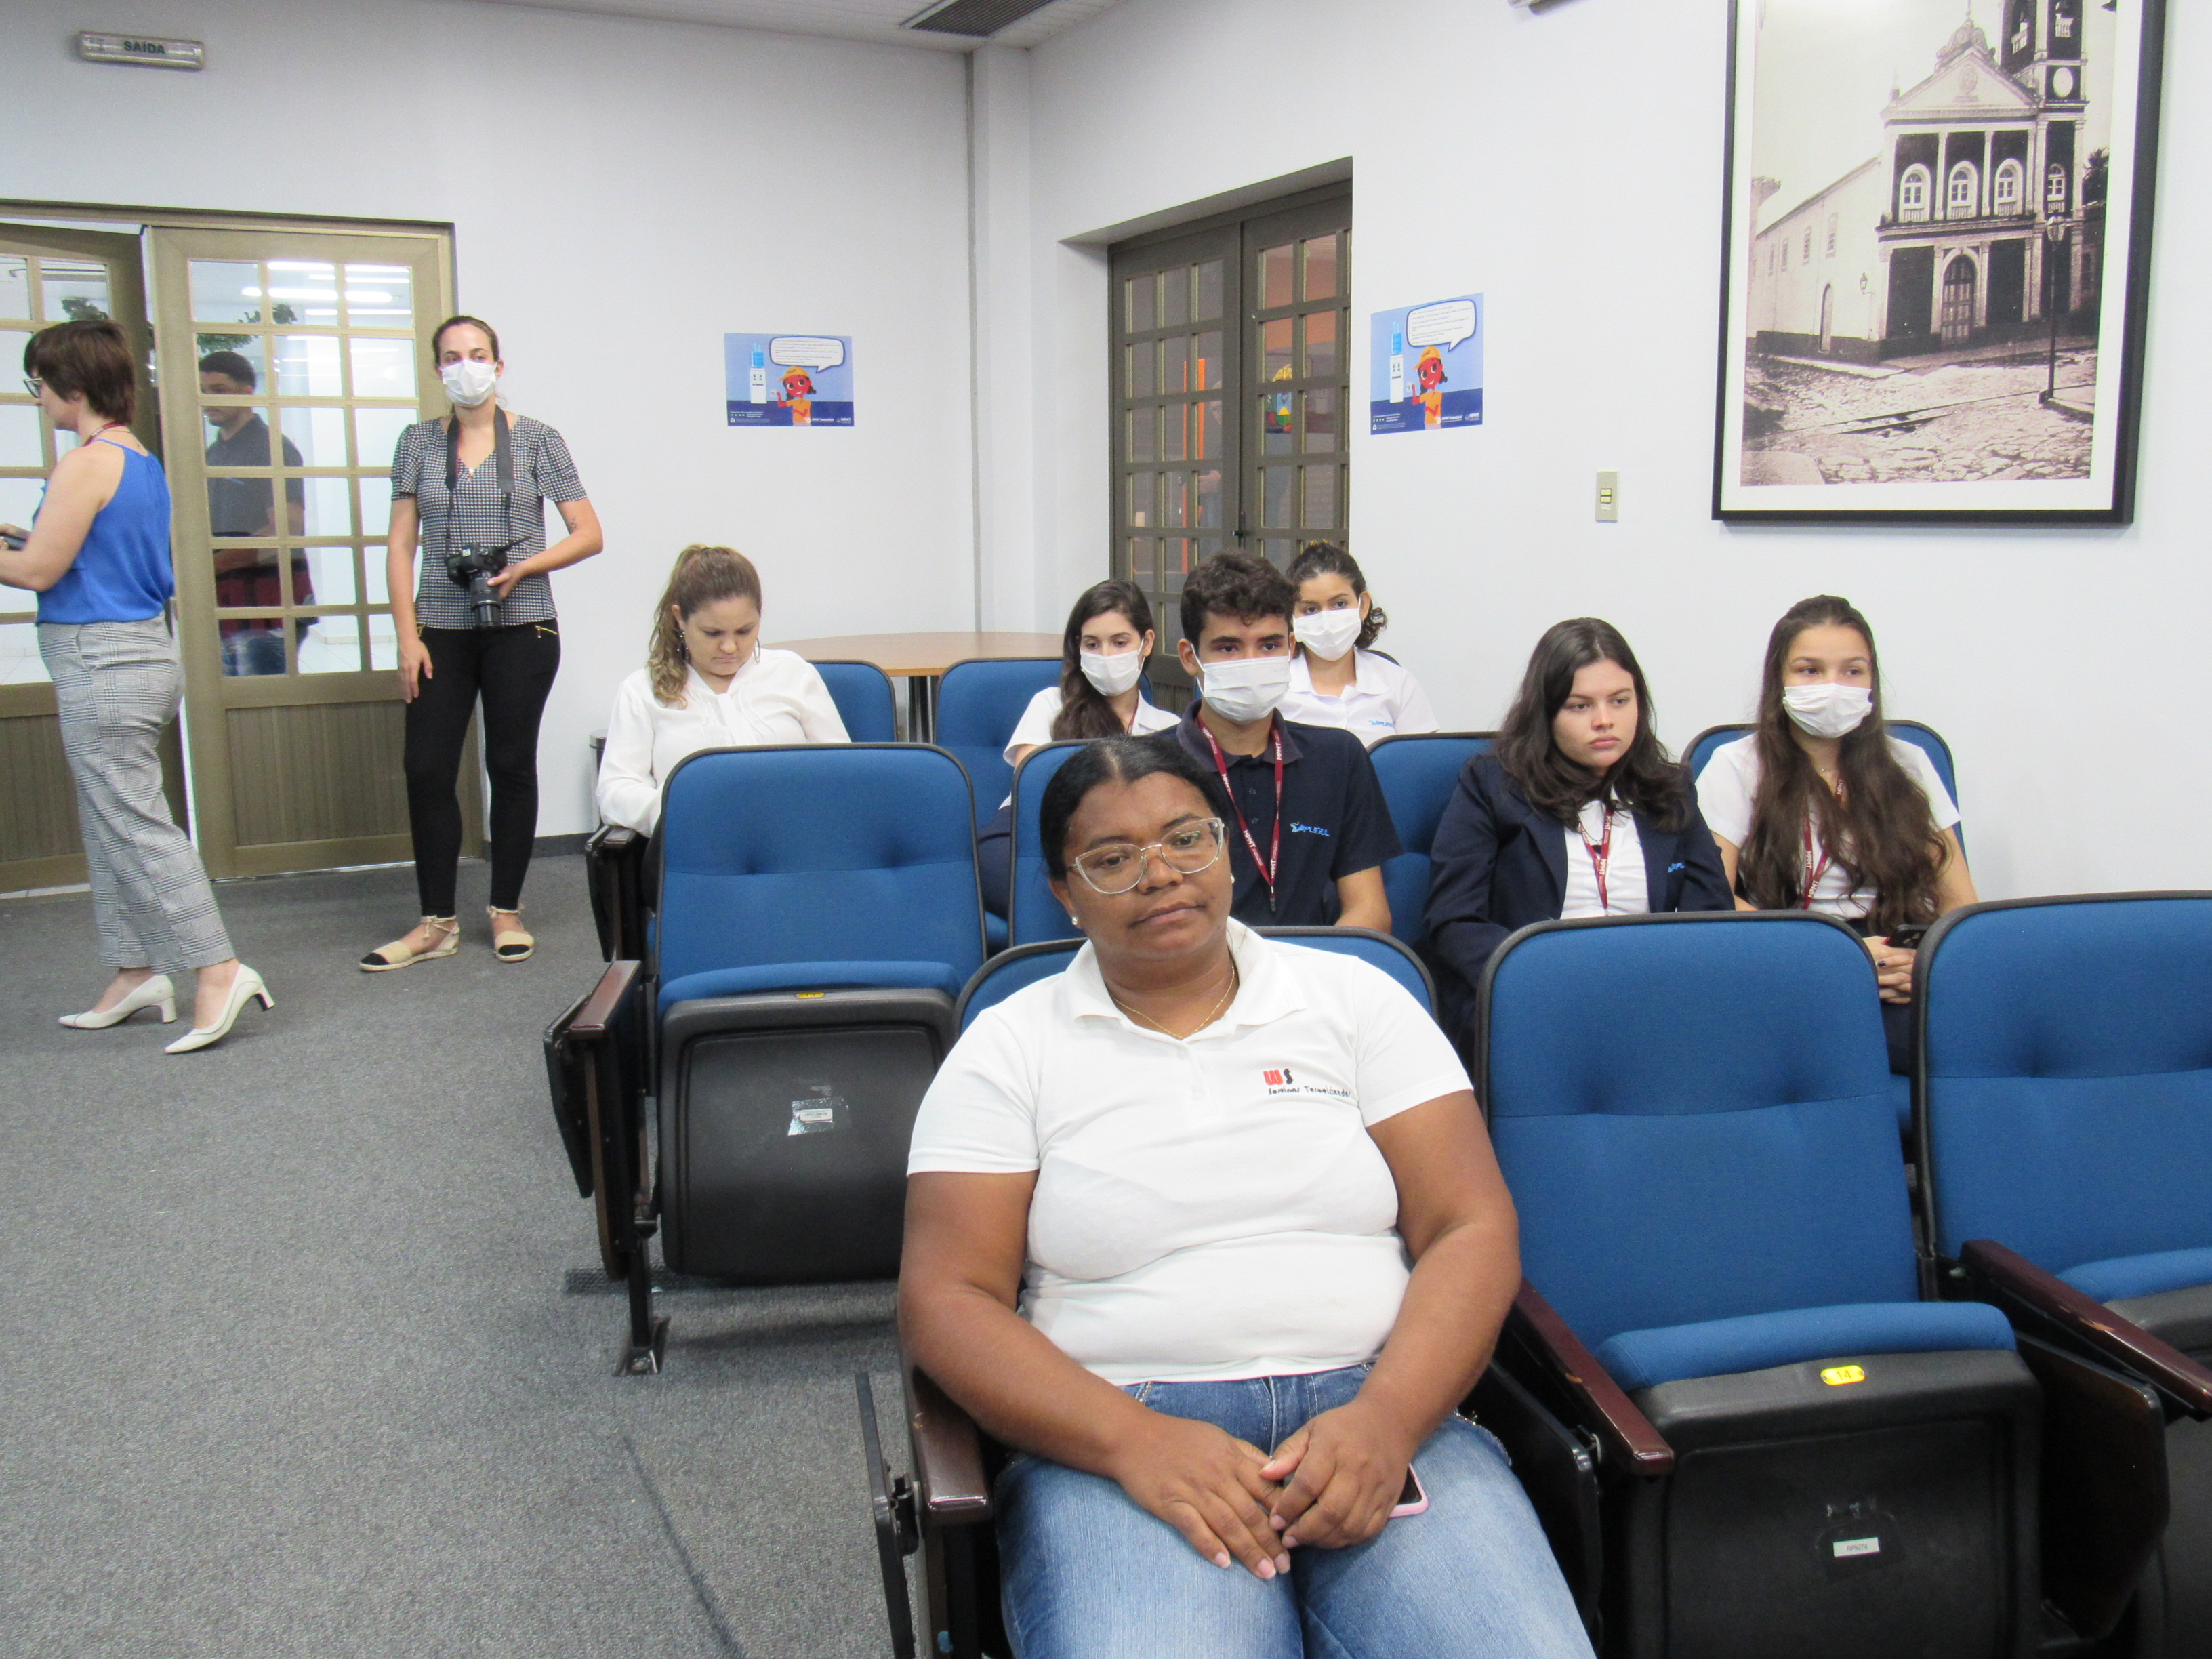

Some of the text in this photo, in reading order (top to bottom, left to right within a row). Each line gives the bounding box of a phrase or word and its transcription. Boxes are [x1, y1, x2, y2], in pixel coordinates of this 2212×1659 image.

[124, 41, 165, 54] SAÍDA
[1243, 830, 1256, 848] MPMT
[1807, 880, 1819, 898] MPMT
[1836, 1369, 1852, 1380] 14
